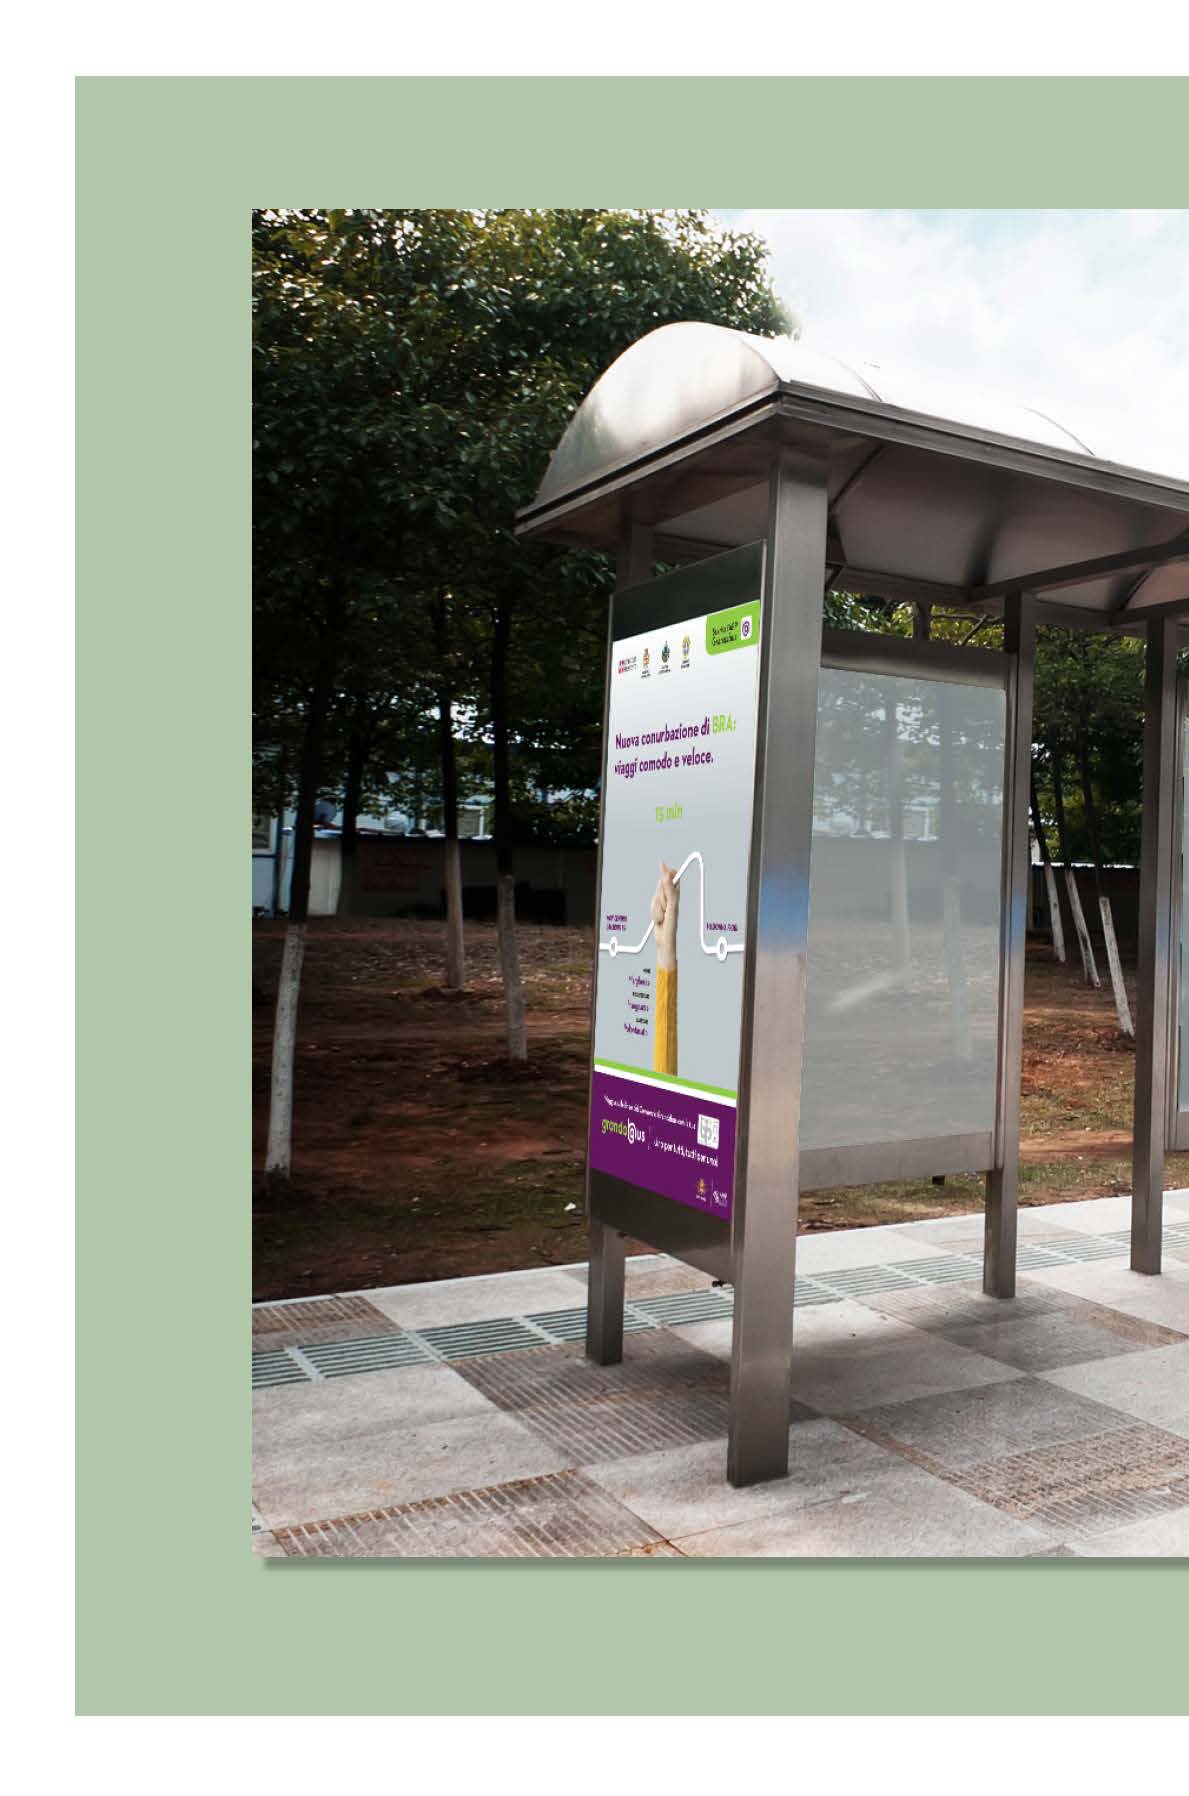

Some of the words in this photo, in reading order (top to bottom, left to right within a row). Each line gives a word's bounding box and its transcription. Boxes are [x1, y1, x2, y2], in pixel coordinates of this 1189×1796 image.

[615, 732, 640, 750] Nuova
[641, 723, 700, 746] conurbazione
[701, 716, 711, 737] di
[712, 712, 737, 734] BRA:
[615, 757, 638, 779] viaggi
[640, 751, 672, 772] comodo
[674, 756, 681, 768] e
[682, 746, 714, 767] veloce.
